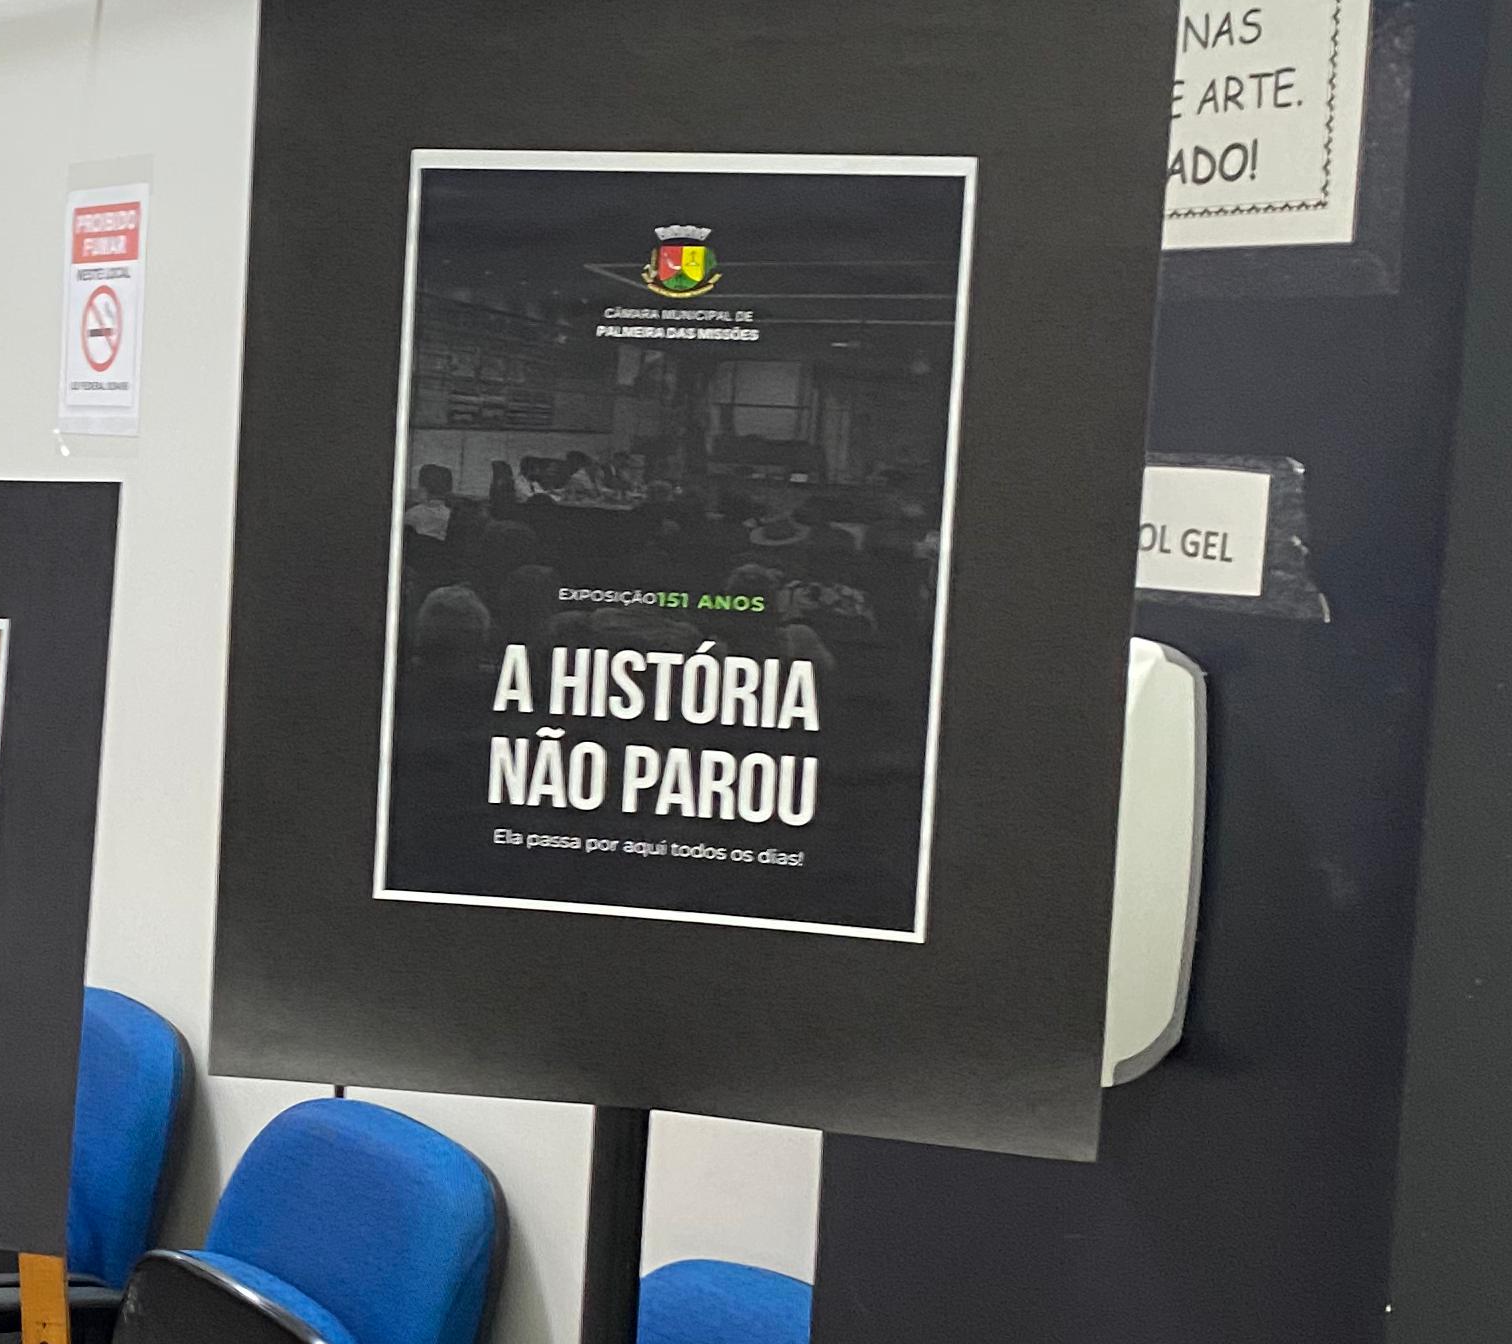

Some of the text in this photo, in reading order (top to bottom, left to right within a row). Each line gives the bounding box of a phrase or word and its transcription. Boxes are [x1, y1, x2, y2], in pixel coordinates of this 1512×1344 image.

[1183, 8, 1263, 53] NAS
[1197, 67, 1303, 115] ARTE.
[596, 325, 760, 341] PALMEIRA DAS MISSÕES
[603, 306, 754, 323] CÂMARA MUNICIPAL DE
[1180, 528, 1233, 563] GEL
[697, 594, 765, 611] ANOS
[492, 640, 820, 732] A HISTÓRIA
[488, 726, 818, 827] NÃO PAROU
[493, 828, 522, 845] Ela
[526, 833, 582, 850] passa
[586, 836, 618, 852] por
[670, 842, 727, 861] todos
[730, 848, 754, 862] os
[757, 848, 805, 867] dias!
